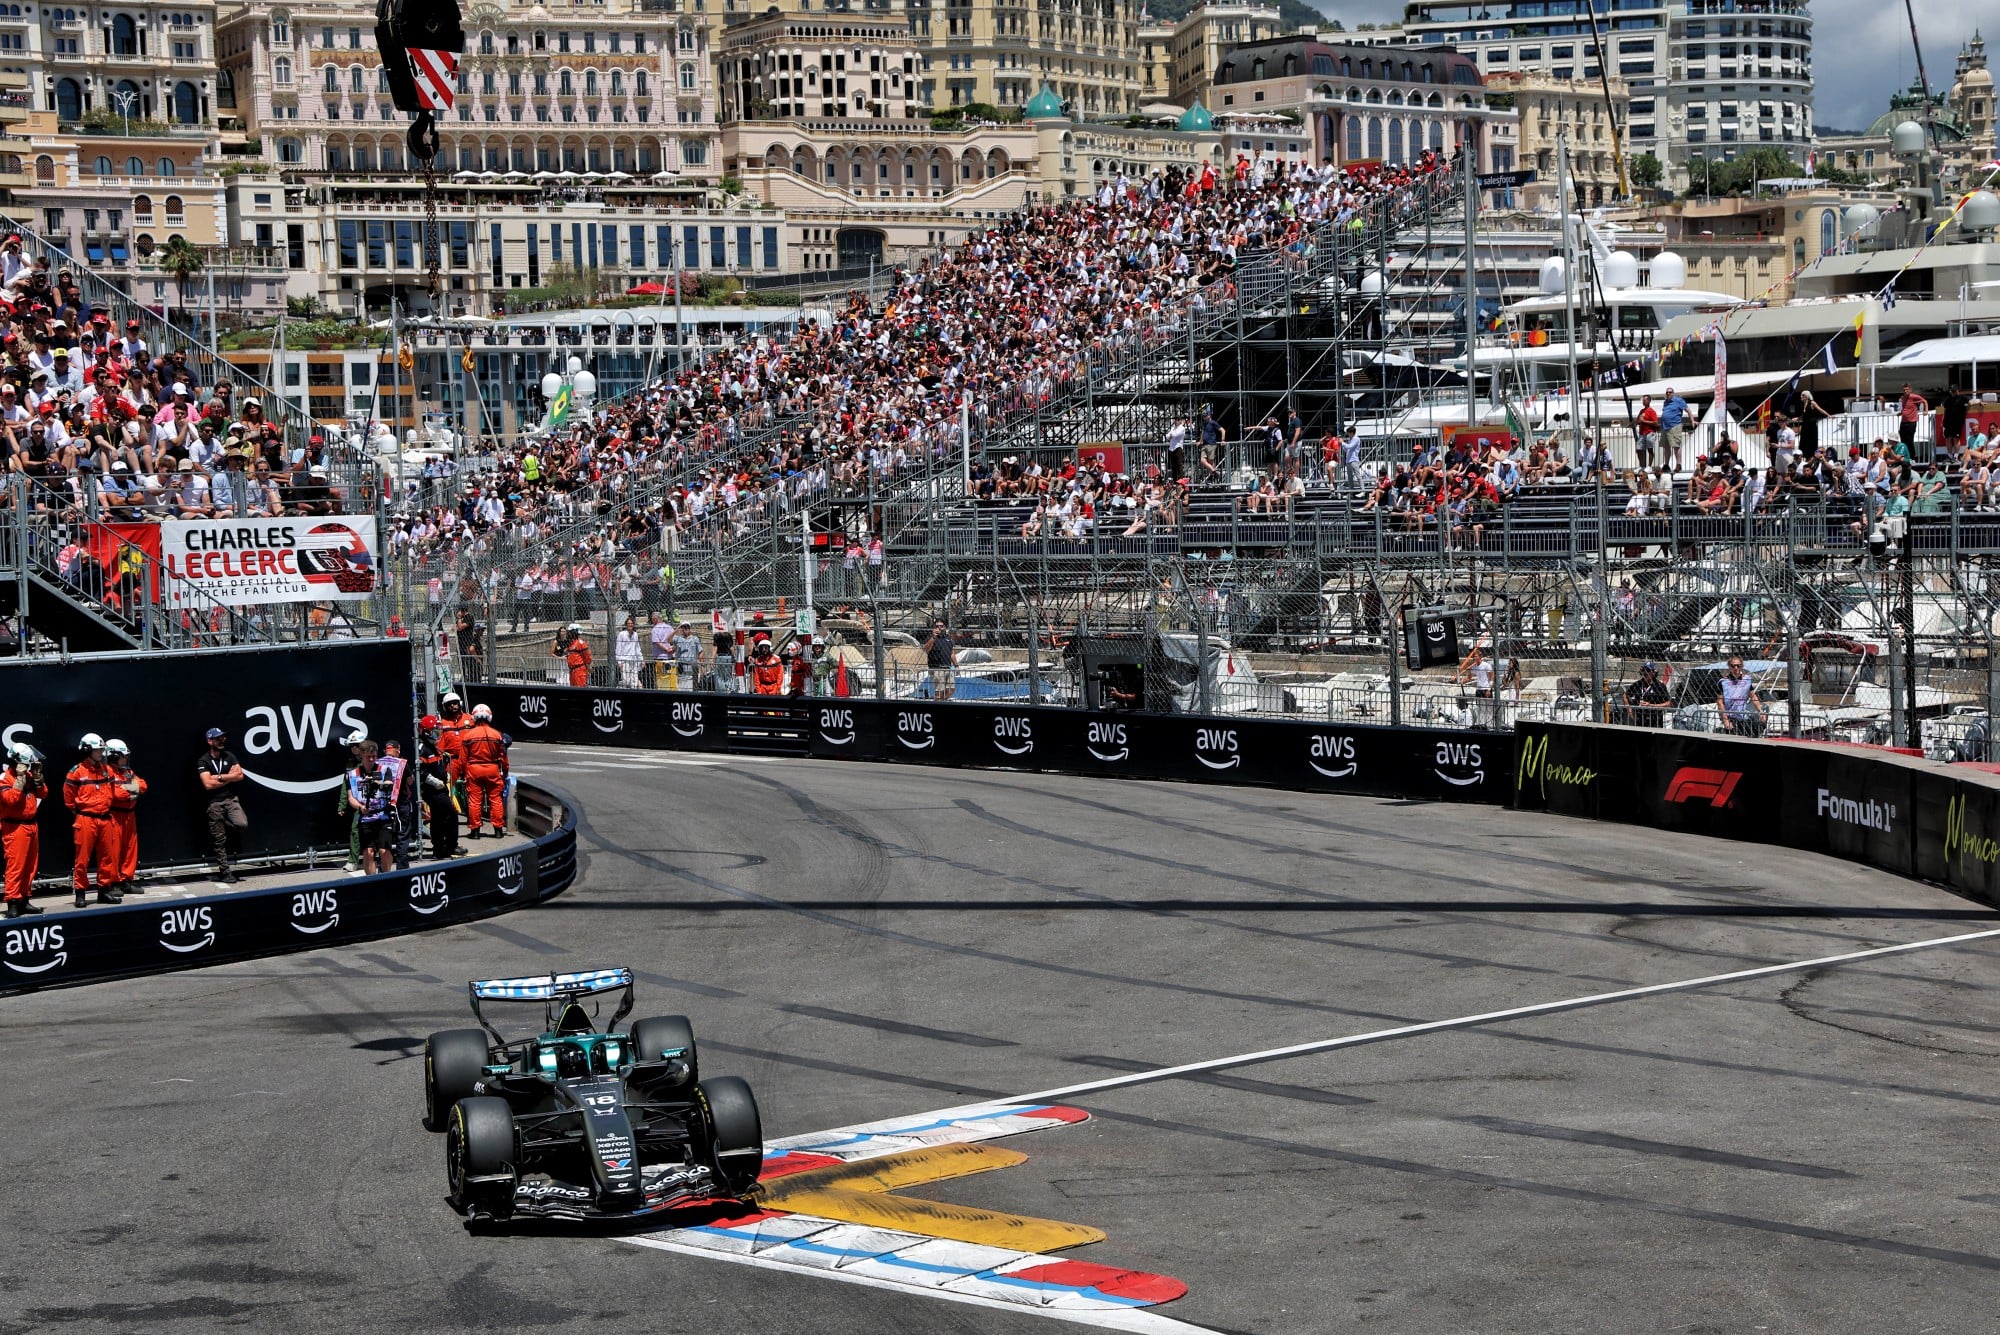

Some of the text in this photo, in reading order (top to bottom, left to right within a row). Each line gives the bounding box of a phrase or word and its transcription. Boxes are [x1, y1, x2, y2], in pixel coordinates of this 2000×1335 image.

[1483, 175, 1516, 186] salesforce
[185, 526, 295, 550] CHARLES
[168, 549, 297, 579] LECLERC
[182, 585, 308, 599] MARCHE FAN CLUB
[200, 577, 290, 589] THE OFFICIAL
[1427, 621, 1444, 633] aws
[520, 695, 547, 713] aws
[593, 699, 622, 717] aws
[672, 702, 702, 721] aws
[243, 699, 368, 754] aws
[820, 709, 853, 728] aws
[898, 712, 932, 732] aws
[995, 717, 1031, 737] aws
[1088, 722, 1127, 744] aws
[1196, 729, 1238, 751] aws
[1310, 735, 1355, 758] aws
[1436, 742, 1481, 766] aws
[1518, 733, 1598, 800] Monaco
[1944, 793, 2000, 877] Monaco
[498, 855, 522, 878] aws
[410, 872, 446, 897] aws
[292, 889, 337, 916] aws
[160, 907, 212, 934] aws
[6, 925, 65, 954] aws
[584, 1095, 617, 1105] 18
[645, 1165, 710, 1192] aramco
[516, 1185, 590, 1198] aramco
